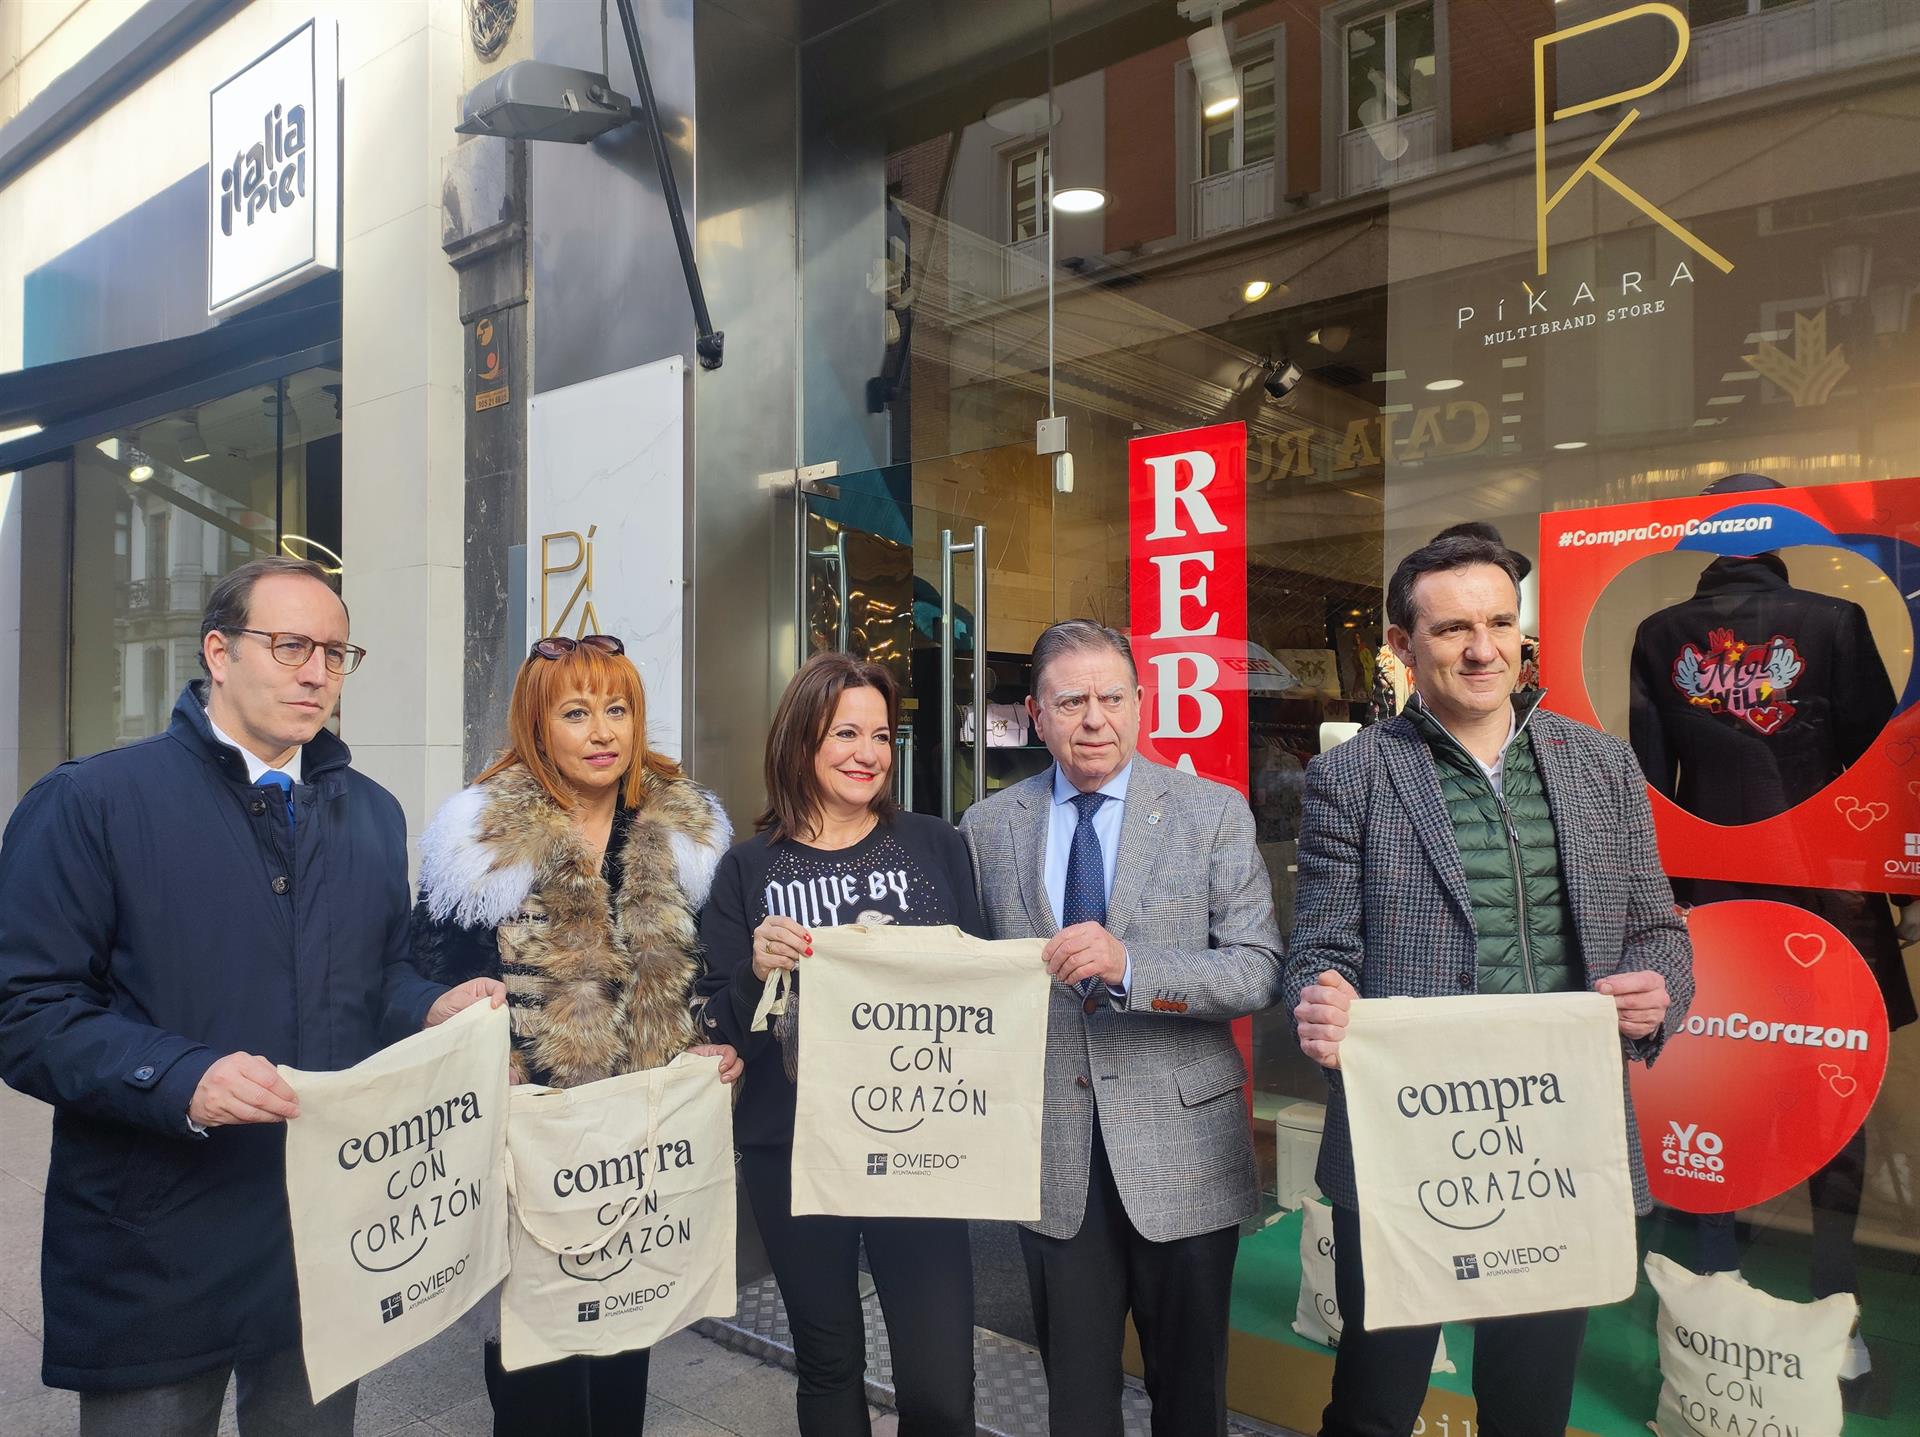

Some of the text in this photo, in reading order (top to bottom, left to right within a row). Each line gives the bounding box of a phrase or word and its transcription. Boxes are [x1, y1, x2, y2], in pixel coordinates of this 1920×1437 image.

[220, 102, 306, 237] italia
[246, 149, 306, 227] piel
[1484, 299, 1667, 347] MULTIBRAND STORE
[1558, 515, 1773, 547] #CompraConCorazon
[867, 869, 910, 913] BY
[852, 1001, 996, 1044] compra
[1676, 1012, 1869, 1051] onCorazon
[890, 1045, 952, 1073] CON
[852, 1079, 987, 1133] CORAZÓN
[1397, 1072, 1567, 1123] compra
[337, 1090, 484, 1171] compra
[1452, 1124, 1524, 1160] CON
[387, 1149, 446, 1200] CON
[1662, 1148, 1724, 1172] creo
[1675, 1166, 1725, 1184] Oviedo
[1418, 1157, 1577, 1231] CORAZÓN
[351, 1177, 482, 1273] CORAZÓN
[1674, 1325, 1805, 1382] compra
[1705, 1372, 1763, 1410] CON
